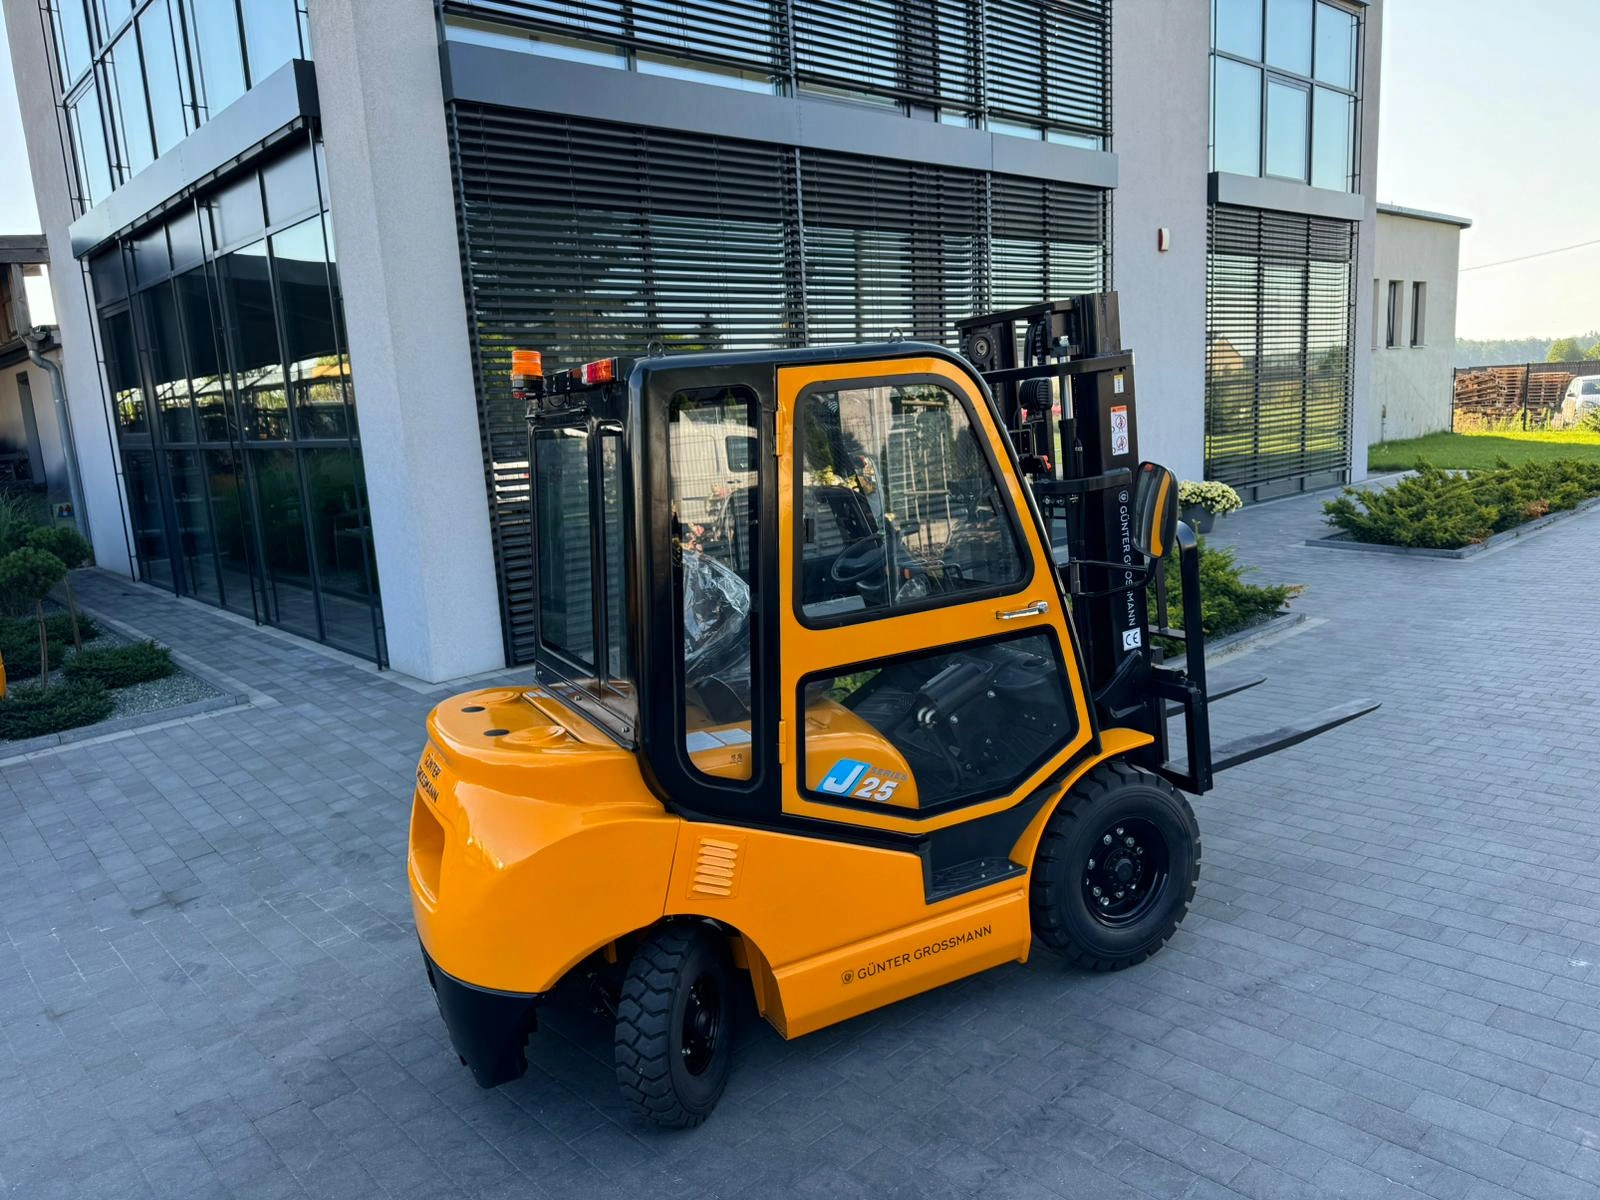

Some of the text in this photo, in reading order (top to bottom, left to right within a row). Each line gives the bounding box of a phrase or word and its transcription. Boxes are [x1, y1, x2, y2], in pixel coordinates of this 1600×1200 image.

[1119, 504, 1137, 627] GÜNTER GOSMANN
[1125, 631, 1139, 647] CE
[822, 764, 865, 794] J
[854, 776, 899, 801] 25
[857, 924, 993, 980] GÜNTER GROSSMANN
